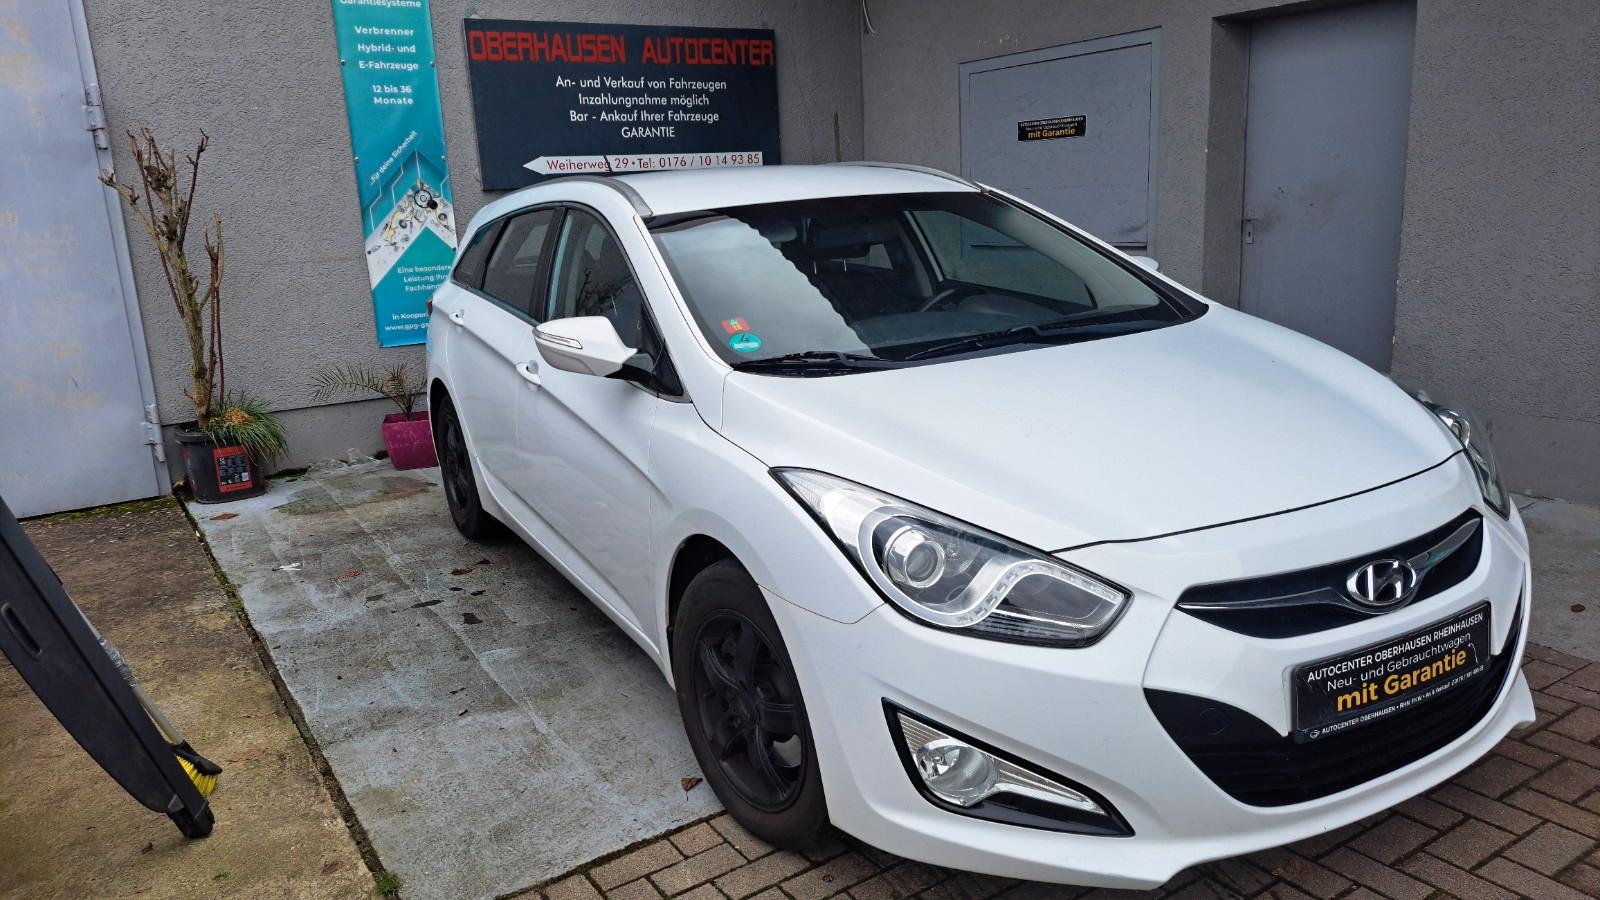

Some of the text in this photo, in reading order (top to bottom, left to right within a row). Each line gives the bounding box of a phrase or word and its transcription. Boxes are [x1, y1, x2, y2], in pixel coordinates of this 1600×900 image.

[354, 26, 414, 36] Verbrenner
[357, 43, 416, 54] Hybrid- und
[468, 31, 774, 66] OBERHAUSEN AUTOCENTER
[359, 61, 419, 71] E-Fahrzeuge
[372, 85, 412, 94] 12 bis 36
[556, 75, 727, 92] An- und Verkauf von Fahrzeugen
[373, 96, 414, 105] Monate
[578, 93, 710, 107] Inzahlungnahme möglich
[570, 110, 588, 122] Bar
[600, 110, 637, 122] Ankauf
[640, 111, 665, 122] Ihrer
[668, 110, 720, 124] Fahrzeuge
[621, 126, 675, 138] GARANTIE
[1028, 127, 1076, 139] mit Garantie
[546, 158, 610, 172] Weiherweg
[614, 158, 629, 169] 29
[636, 157, 656, 169] Tel:
[659, 156, 687, 168] 0176
[699, 155, 712, 166] 10
[716, 155, 728, 165] 14
[731, 154, 744, 165] 93
[747, 153, 760, 164] 85
[397, 266, 414, 274] Eine
[1307, 612, 1484, 683] AUTOCENTER OBERHAUSEN RHEINHAUSEN
[1327, 632, 1471, 692] Neu- und Gebrauchtwagen
[1337, 681, 1379, 712] mit
[1384, 649, 1467, 696] Garantie
[1321, 717, 1359, 735] AUTOCENTER
[1360, 705, 1396, 722] OBERHAUSEN
